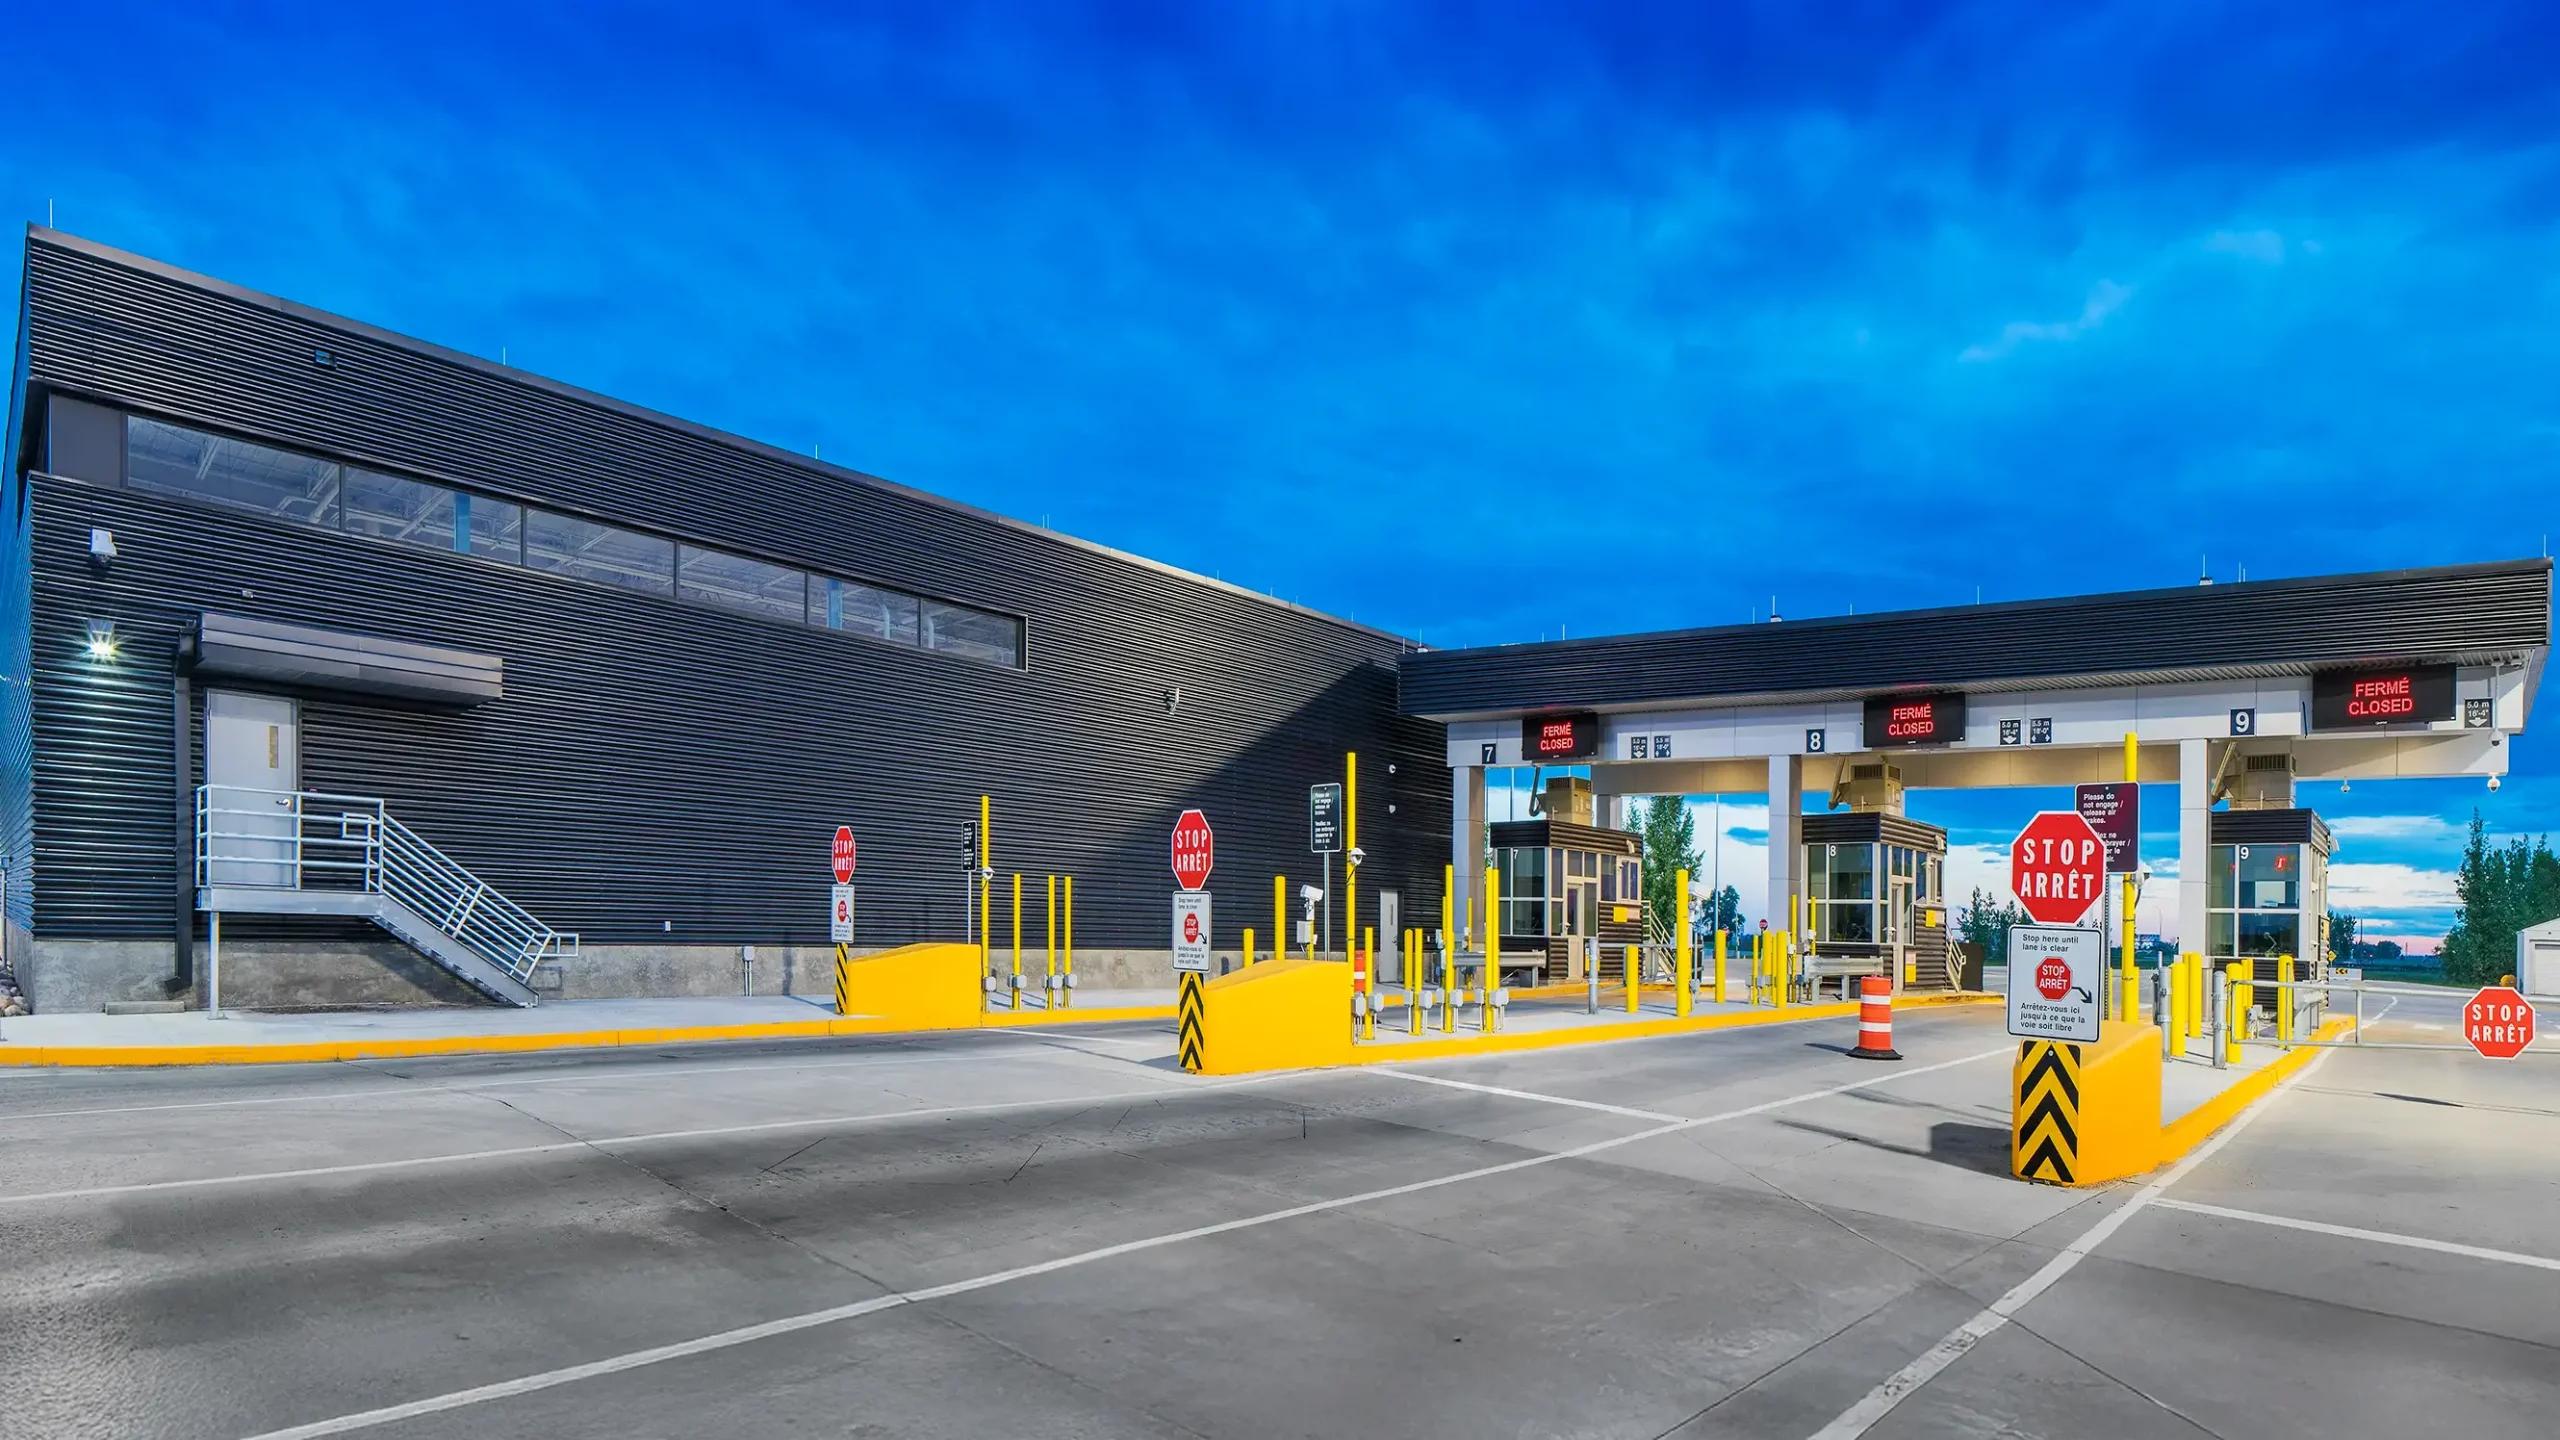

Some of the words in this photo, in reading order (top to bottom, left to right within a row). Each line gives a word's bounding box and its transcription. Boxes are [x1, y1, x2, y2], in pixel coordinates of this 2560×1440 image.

[2355, 676, 2409, 697] FERMÉ
[1893, 703, 1931, 720] FERMÉ
[2348, 698, 2413, 715] CLOSED
[2467, 701, 2479, 709] 5.0
[1888, 721, 1934, 736] CLOSED
[2235, 711, 2250, 733] 9
[1543, 722, 1571, 737] FERMÉ
[1540, 737, 1574, 751] CLOSED
[1810, 731, 1821, 751] 8
[1484, 746, 1494, 763] 7
[2105, 792, 2115, 800] do
[2095, 801, 2119, 809] engage
[1176, 829, 1208, 849] STOP
[834, 840, 853, 854] STOP
[1829, 845, 1837, 857] 8
[2022, 837, 2095, 865] STOP
[2240, 846, 2249, 860] 9
[1176, 849, 1208, 872] ARRÊT
[1513, 849, 1519, 860] 7
[2020, 867, 2094, 900] ARRÊT
[2022, 933, 2040, 943] Stop
[2042, 935, 2059, 943] here
[2061, 936, 2079, 944] until
[2022, 943, 2038, 951] lane
[2042, 964, 2065, 976] STOP
[2039, 976, 2068, 990] ARRÊT
[2020, 1002, 2068, 1013] Arrêtez-vous
[2070, 1006, 2080, 1014] ici
[2472, 1003, 2527, 1022] STOP
[2020, 1011, 2047, 1021] jusqu'à
[2060, 1015, 2076, 1023] que
[2020, 1021, 2036, 1029] voie
[2038, 1022, 2053, 1030] soit
[2055, 1023, 2073, 1032] libre
[2471, 1023, 2527, 1044] ARRÊT
